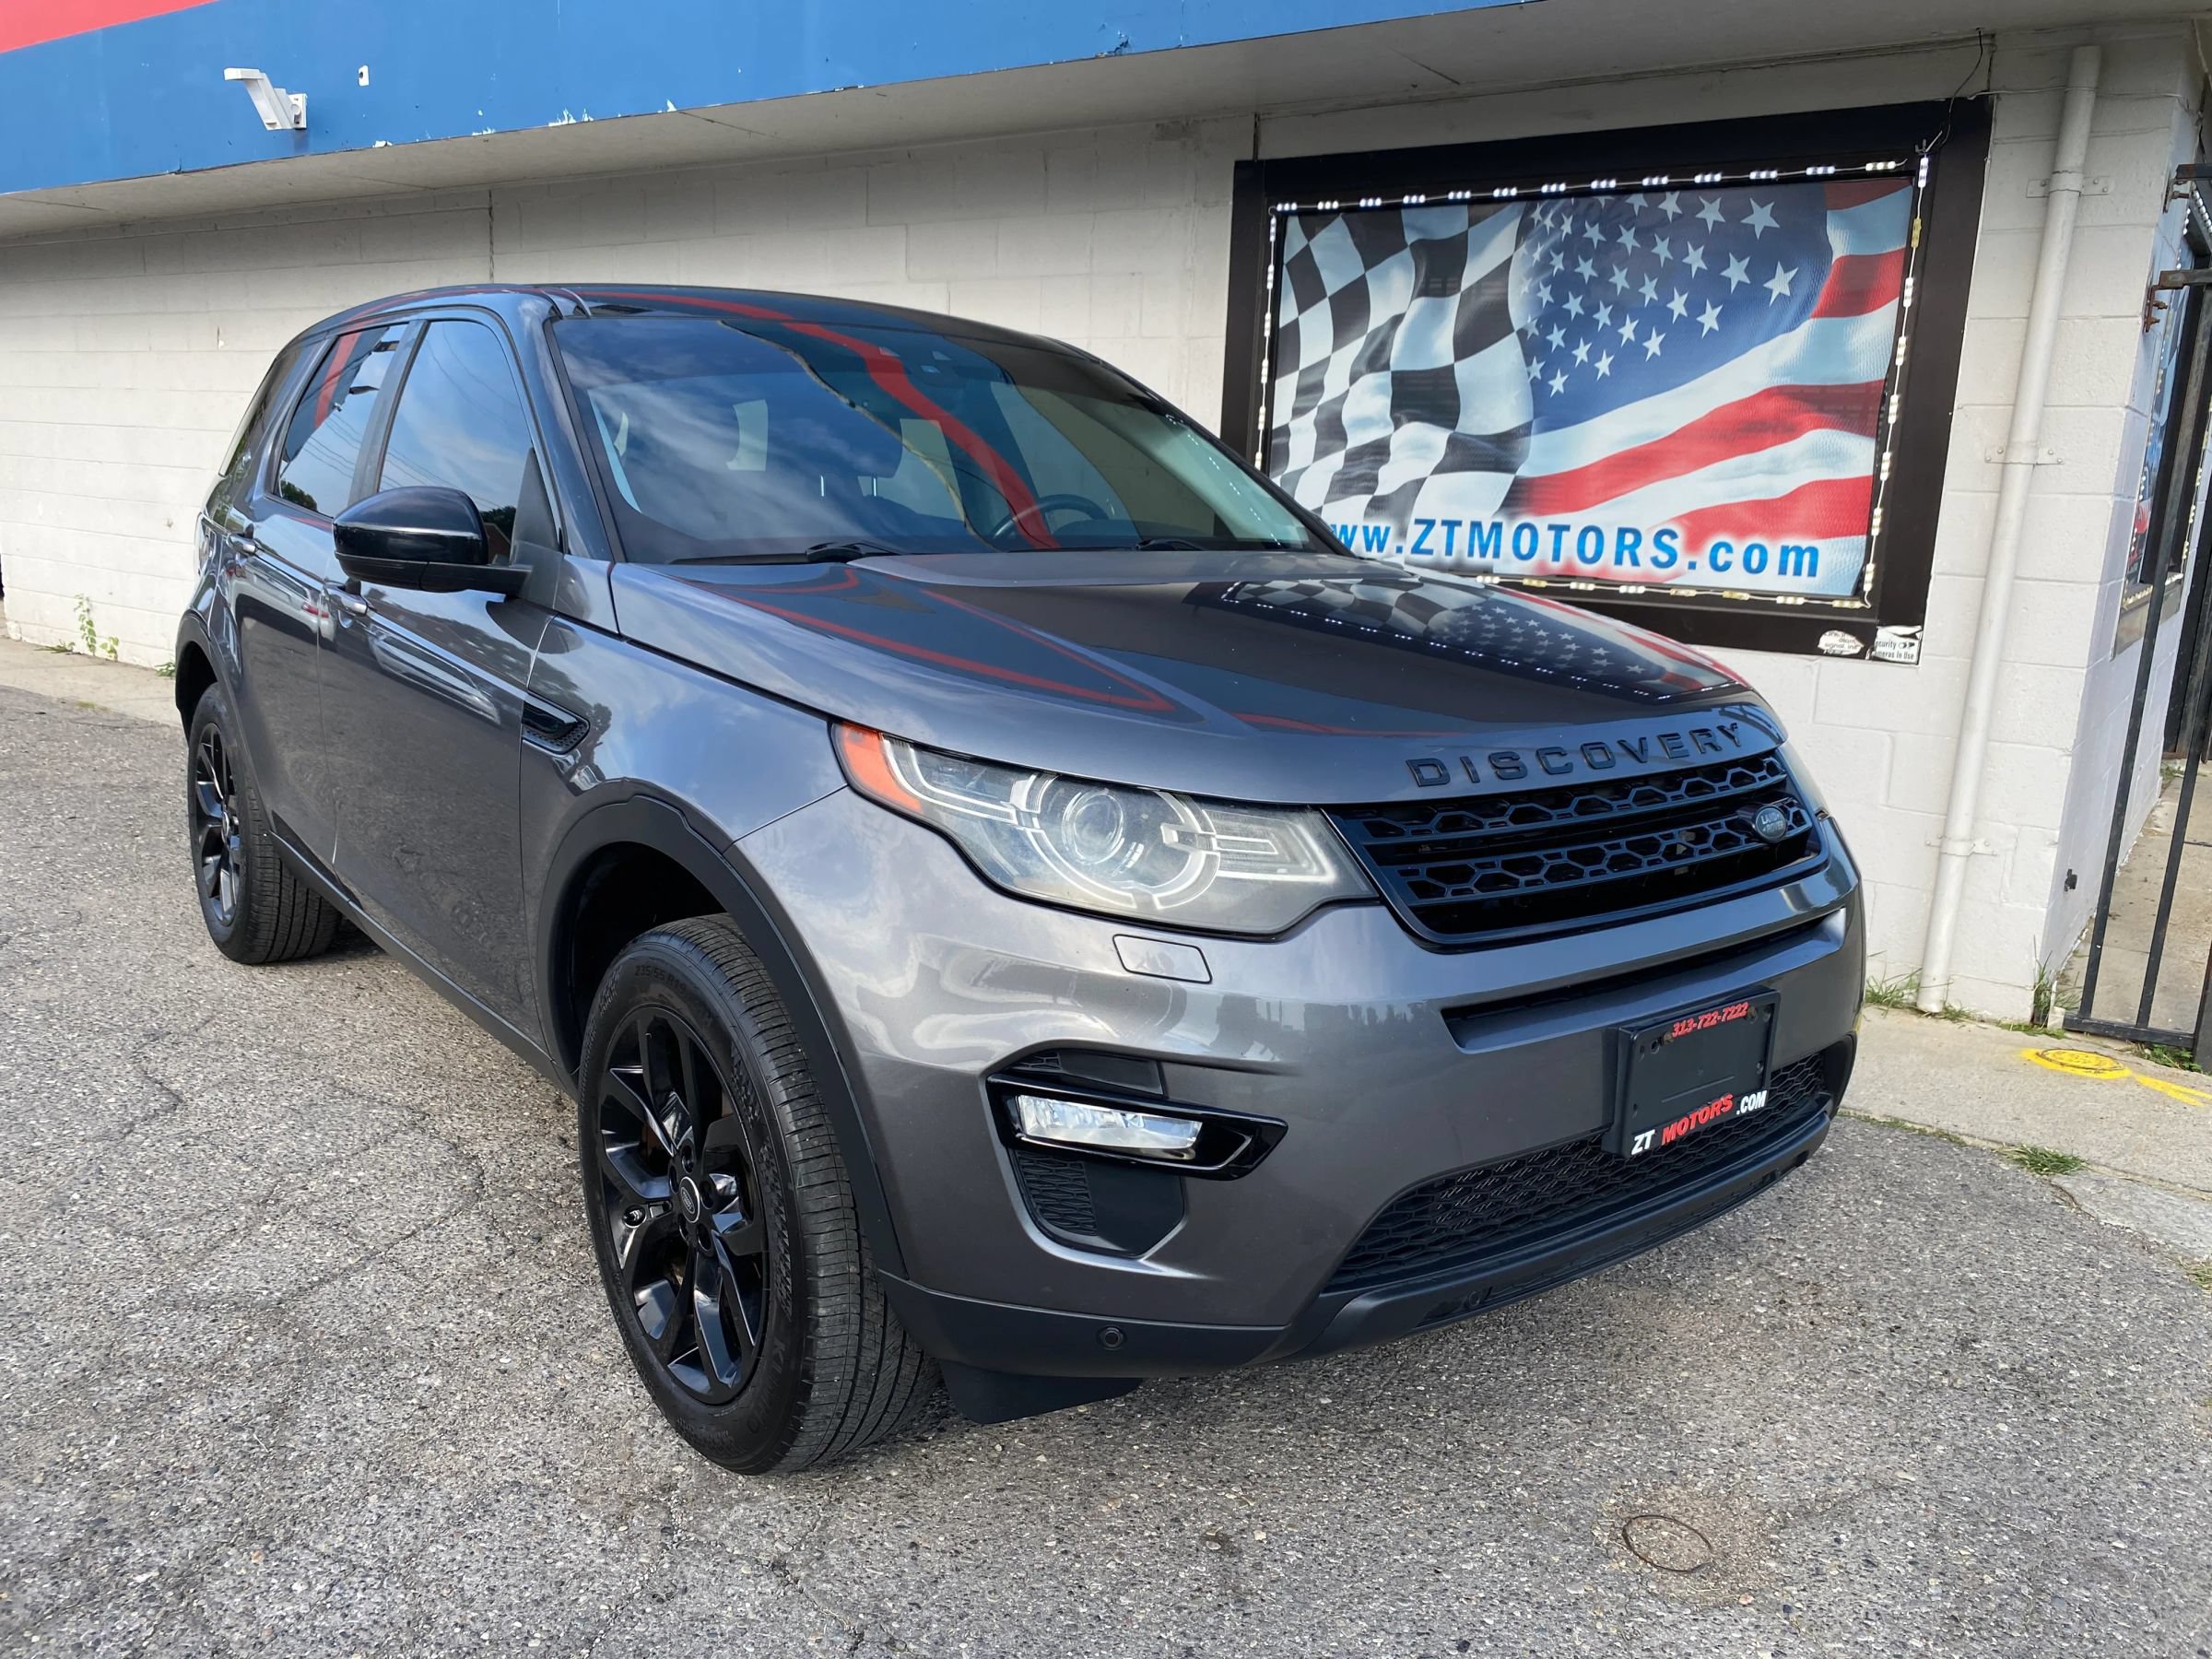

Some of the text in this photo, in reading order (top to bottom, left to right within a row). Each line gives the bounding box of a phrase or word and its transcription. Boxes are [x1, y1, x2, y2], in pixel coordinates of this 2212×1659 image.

[1406, 722, 1741, 787] DISCOVERY
[1672, 1002, 1749, 1038] 313-722-7222
[1631, 1090, 1768, 1155] ZT MOTORS .COM
